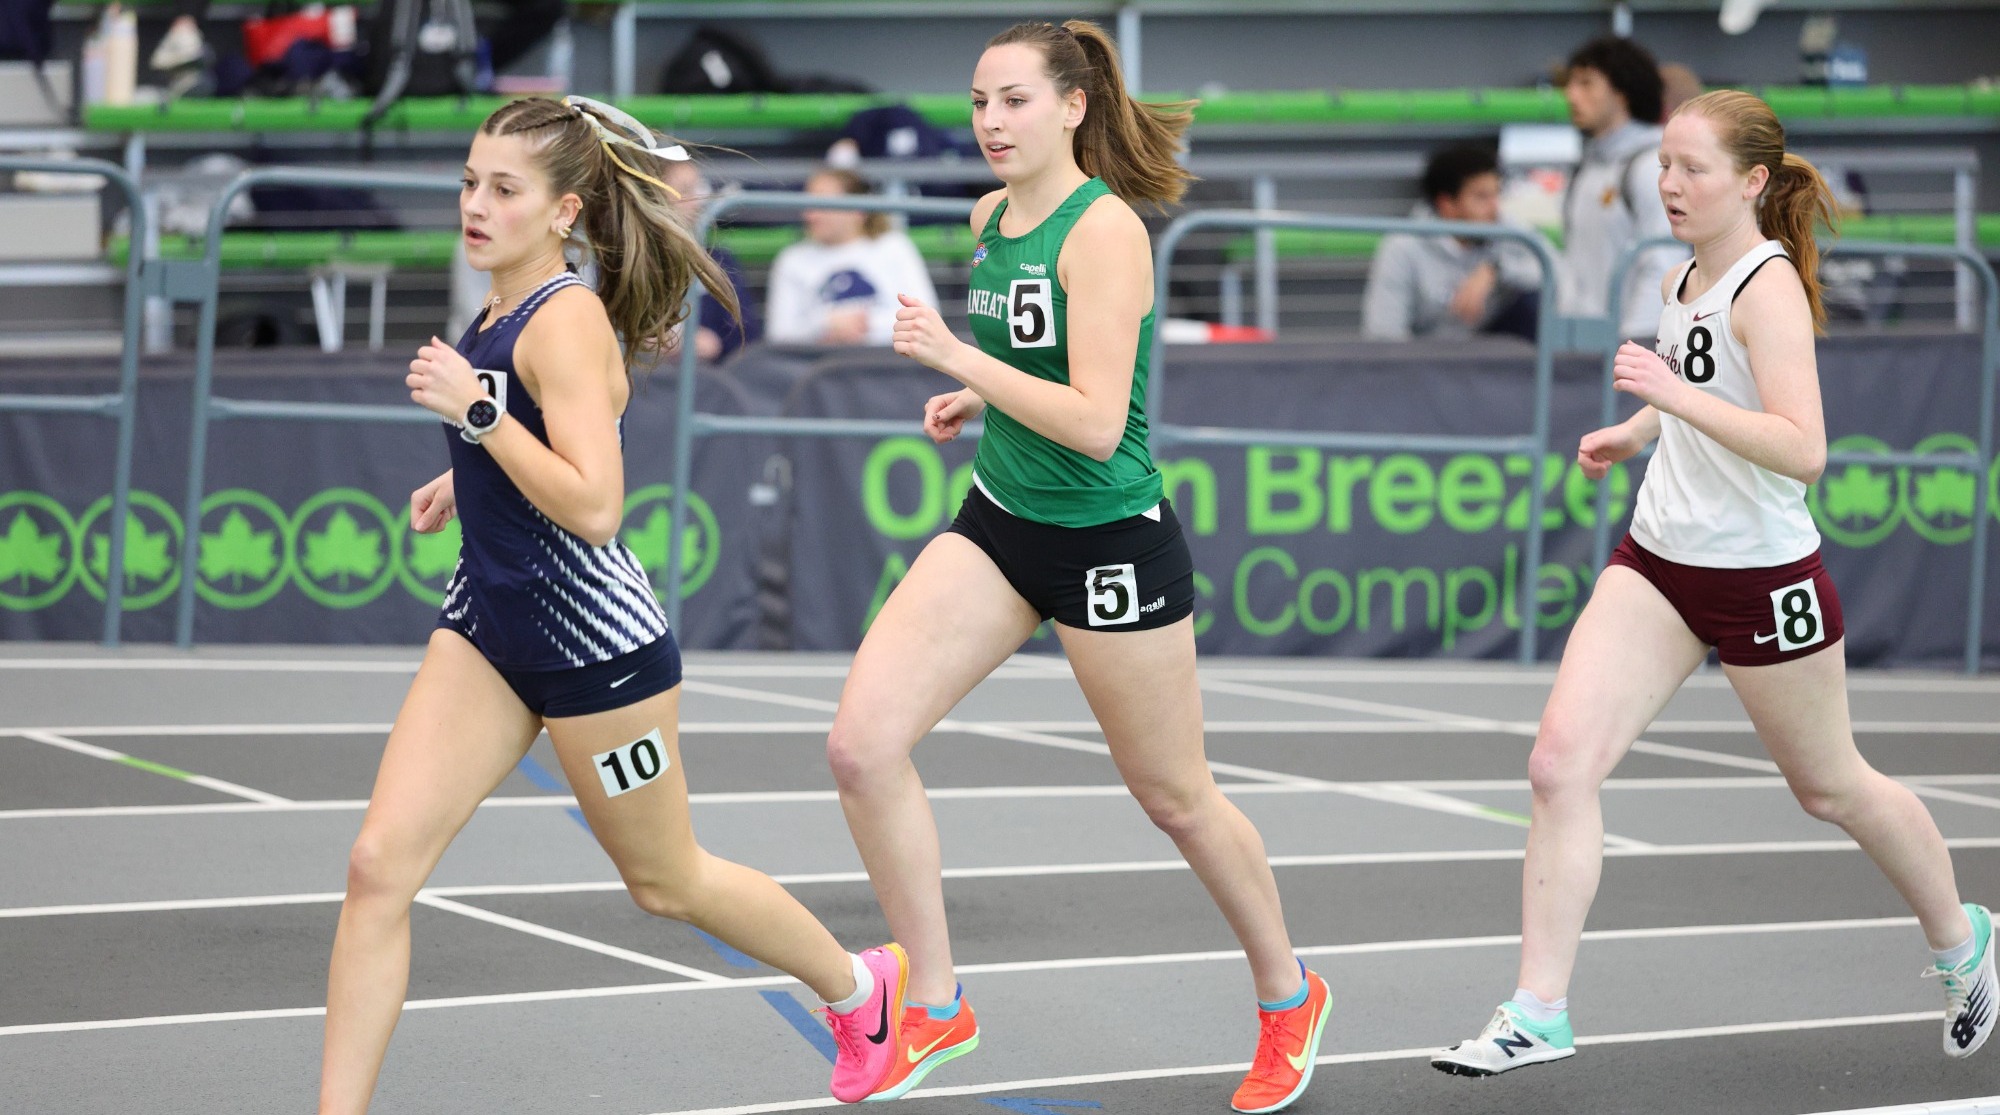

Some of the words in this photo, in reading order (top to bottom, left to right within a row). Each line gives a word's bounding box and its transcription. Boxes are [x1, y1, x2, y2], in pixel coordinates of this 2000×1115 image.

[1013, 284, 1045, 343] 5
[1684, 325, 1716, 384] 8
[1246, 446, 1631, 535] Breeze
[1093, 568, 1129, 621] 5
[1781, 588, 1817, 645] 8
[601, 738, 661, 791] 10
